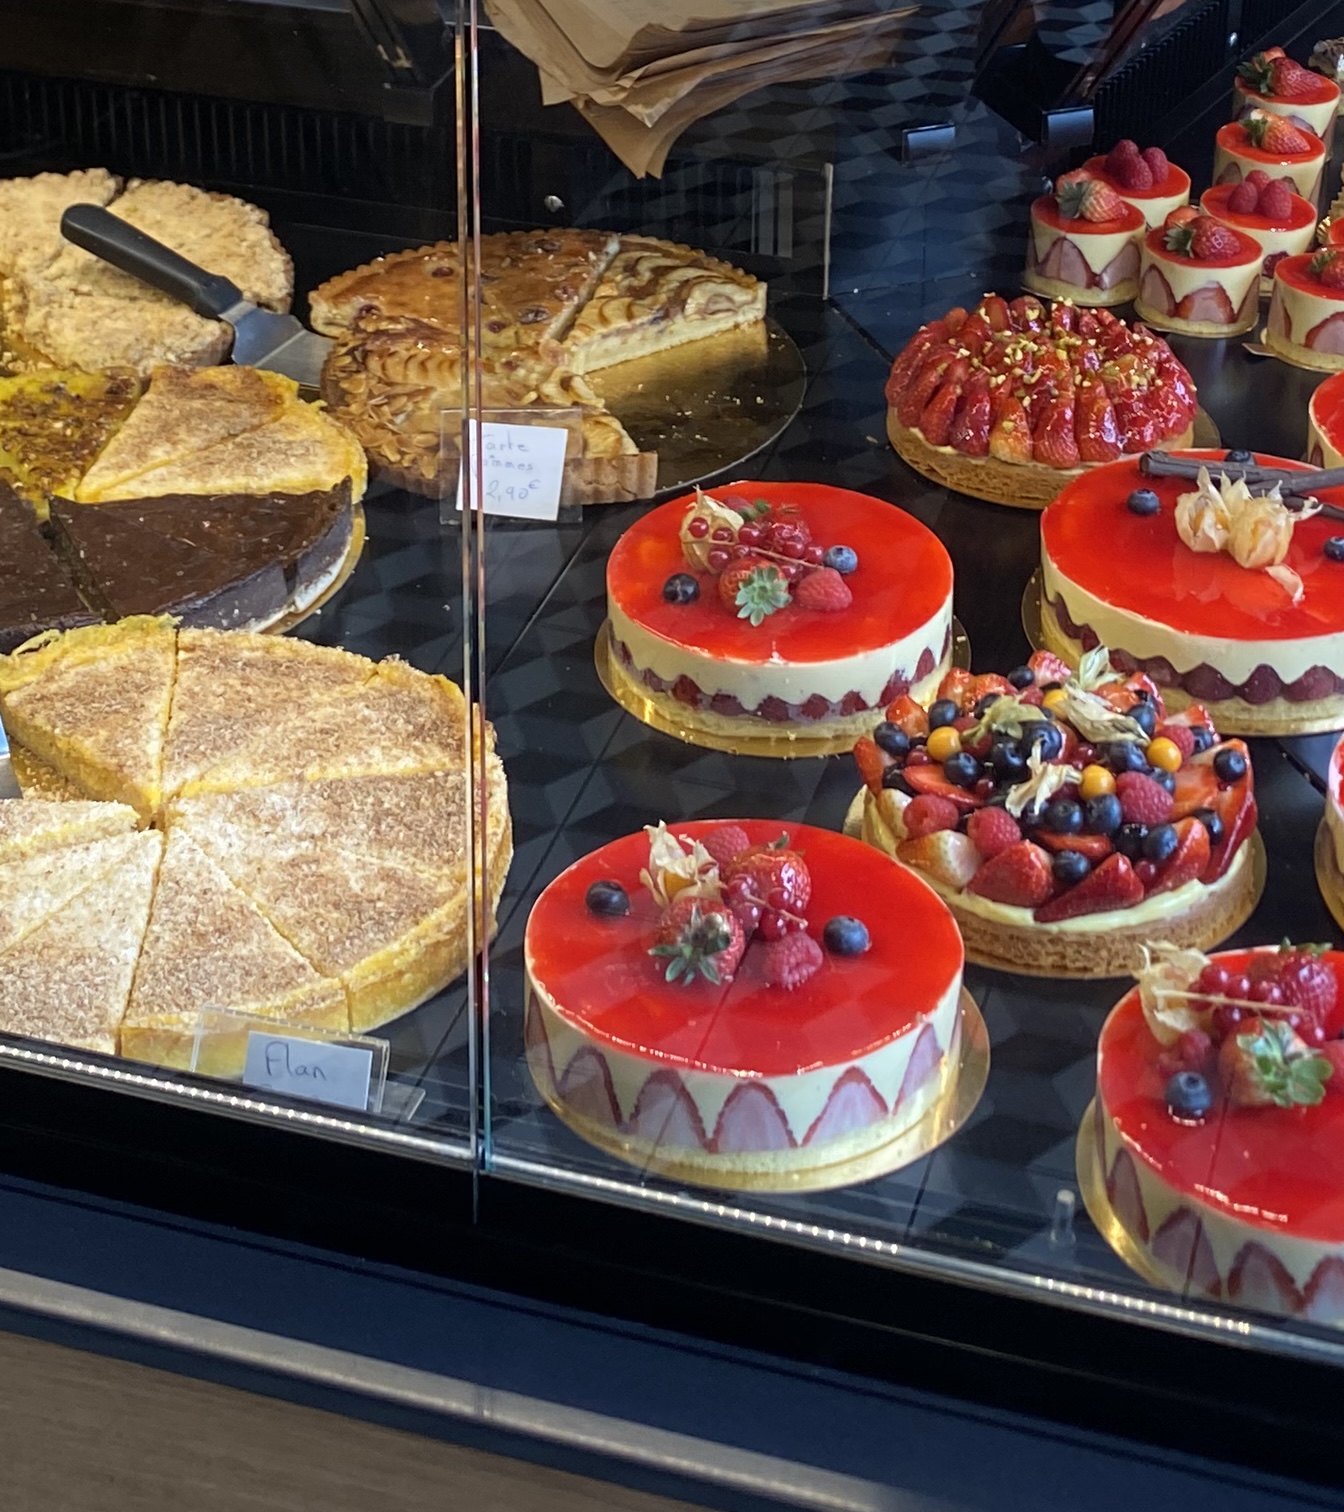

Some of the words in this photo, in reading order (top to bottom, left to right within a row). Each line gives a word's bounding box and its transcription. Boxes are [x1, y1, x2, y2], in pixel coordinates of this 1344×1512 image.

[483, 430, 529, 452] arte
[485, 479, 542, 503] 2,90€
[264, 1040, 327, 1081] Flan
